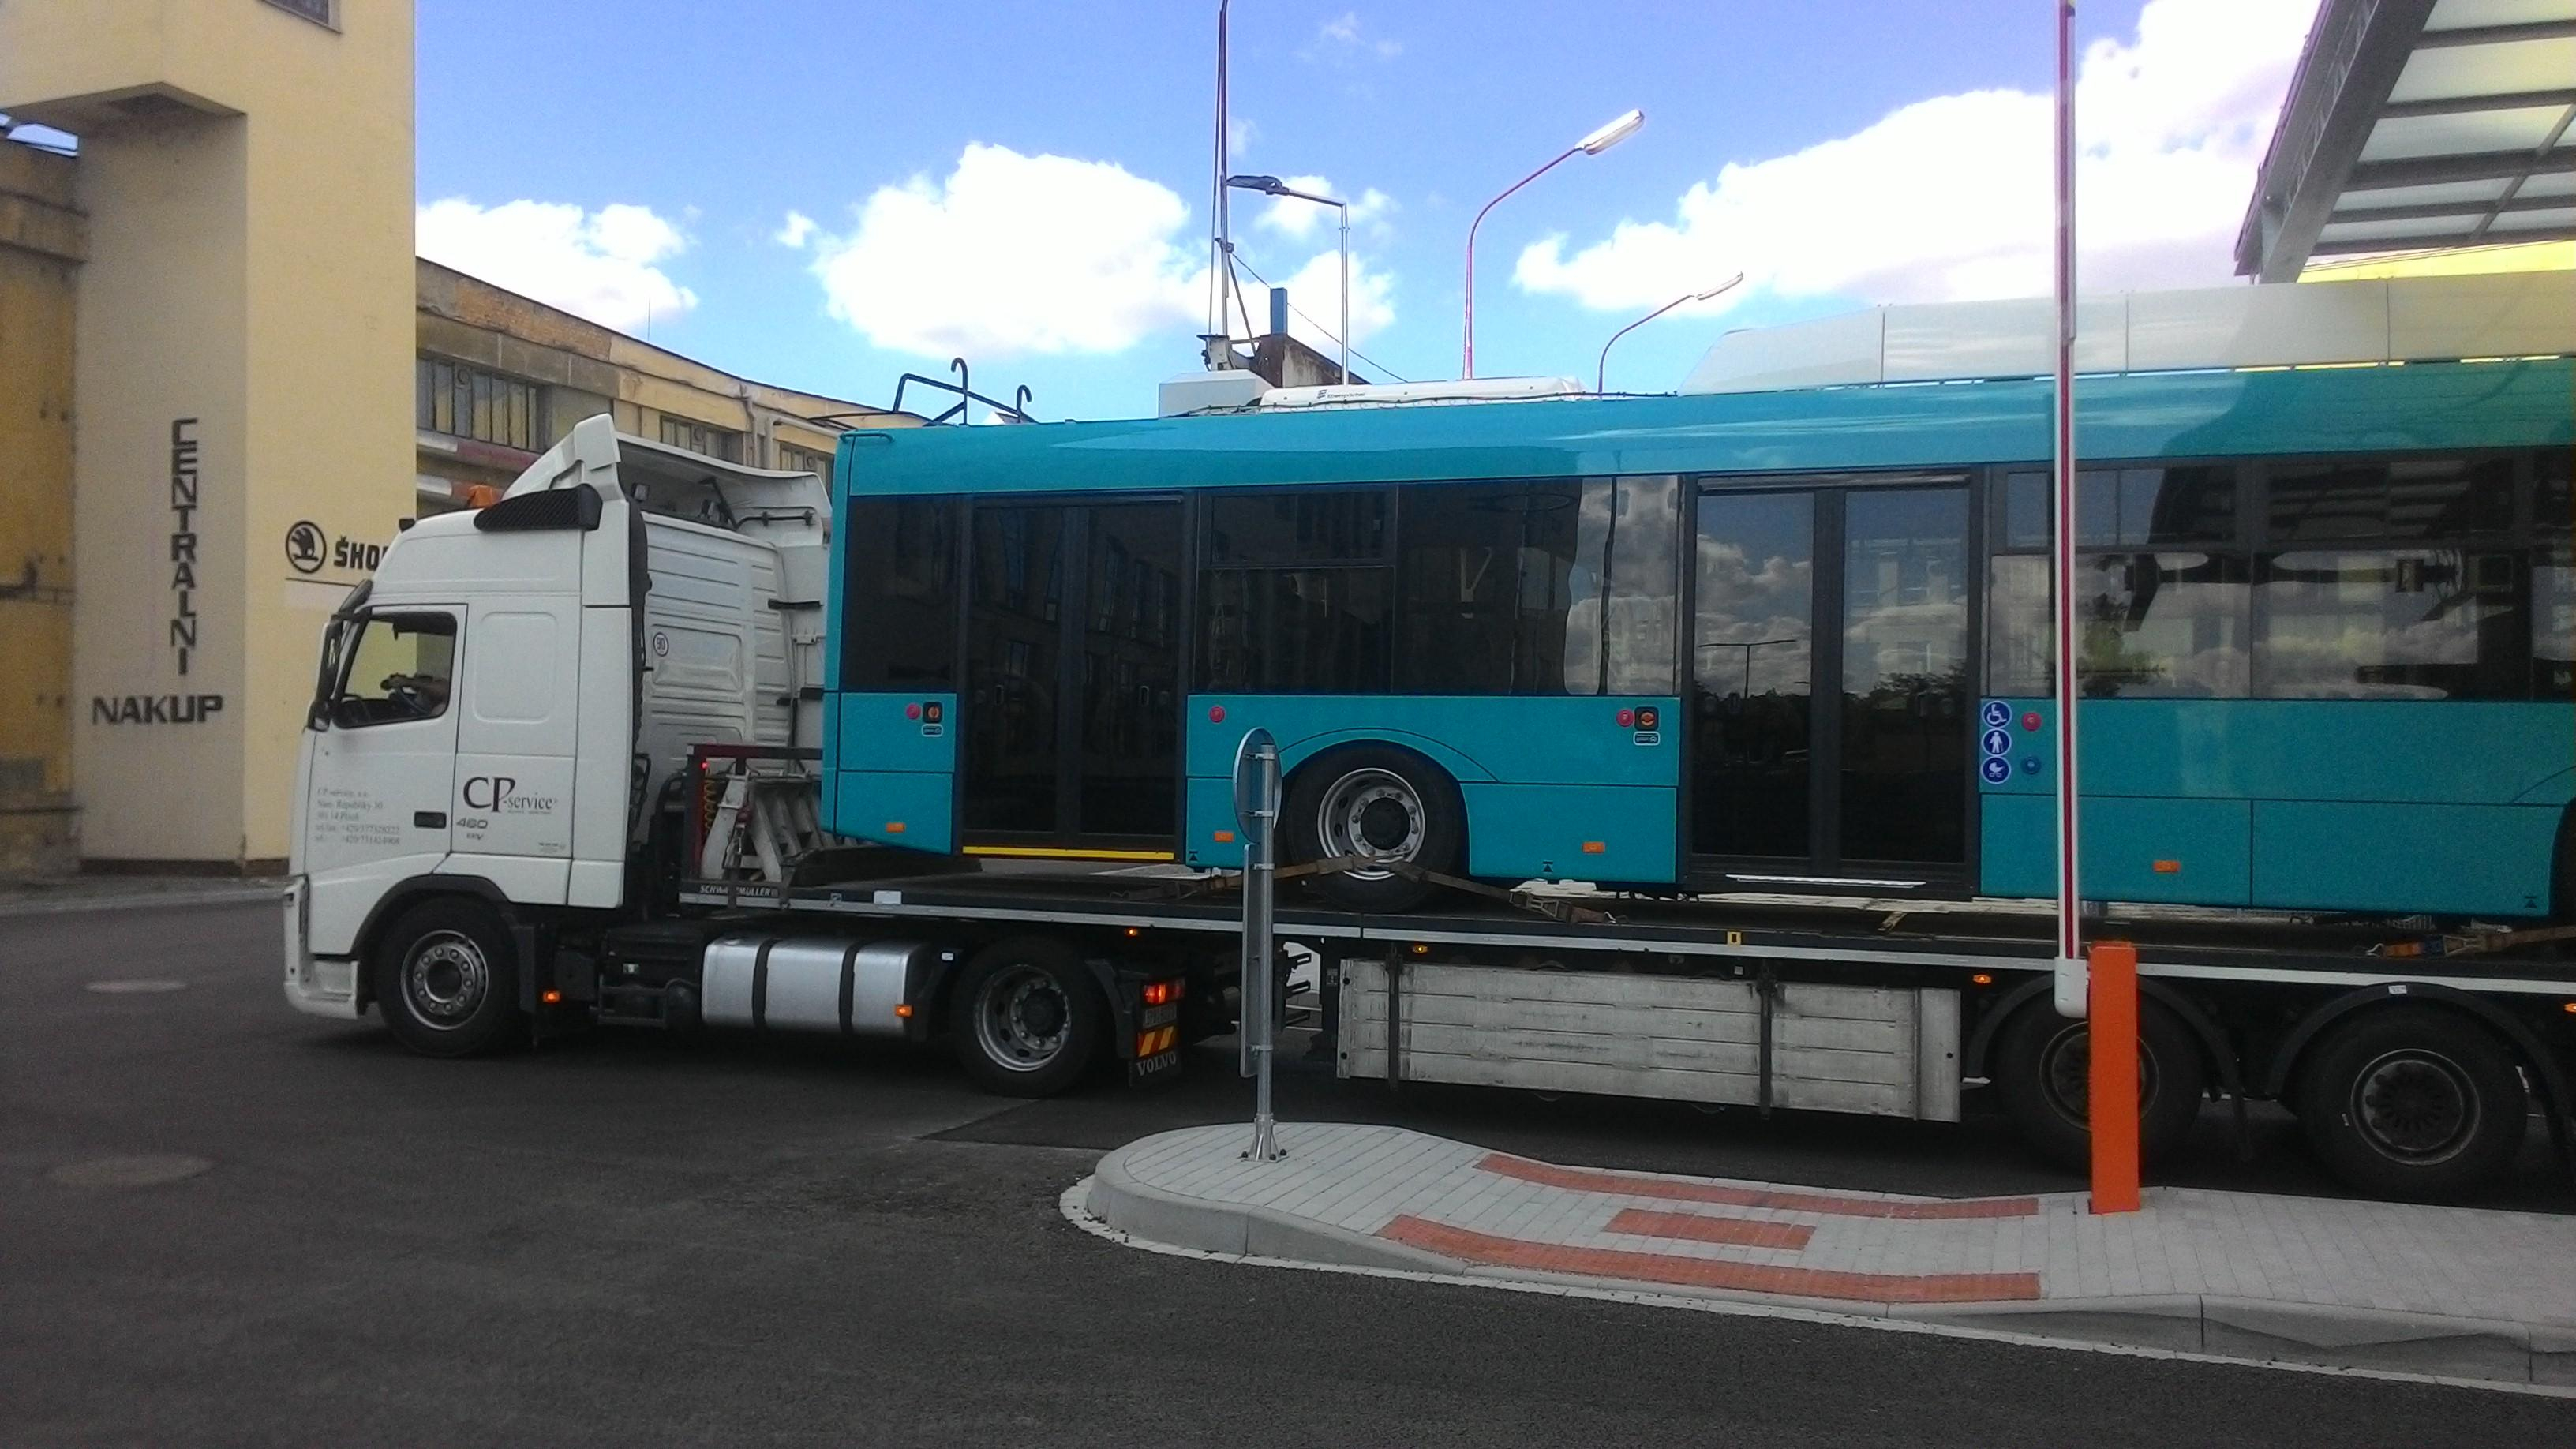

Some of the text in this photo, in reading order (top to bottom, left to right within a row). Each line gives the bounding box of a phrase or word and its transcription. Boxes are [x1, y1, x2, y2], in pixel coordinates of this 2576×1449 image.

[656, 637, 666, 650] 90
[92, 694, 223, 725] NAKUP
[700, 884, 771, 897] SCHWAMÜLLER
[1136, 1052, 1176, 1076] VOLVO
